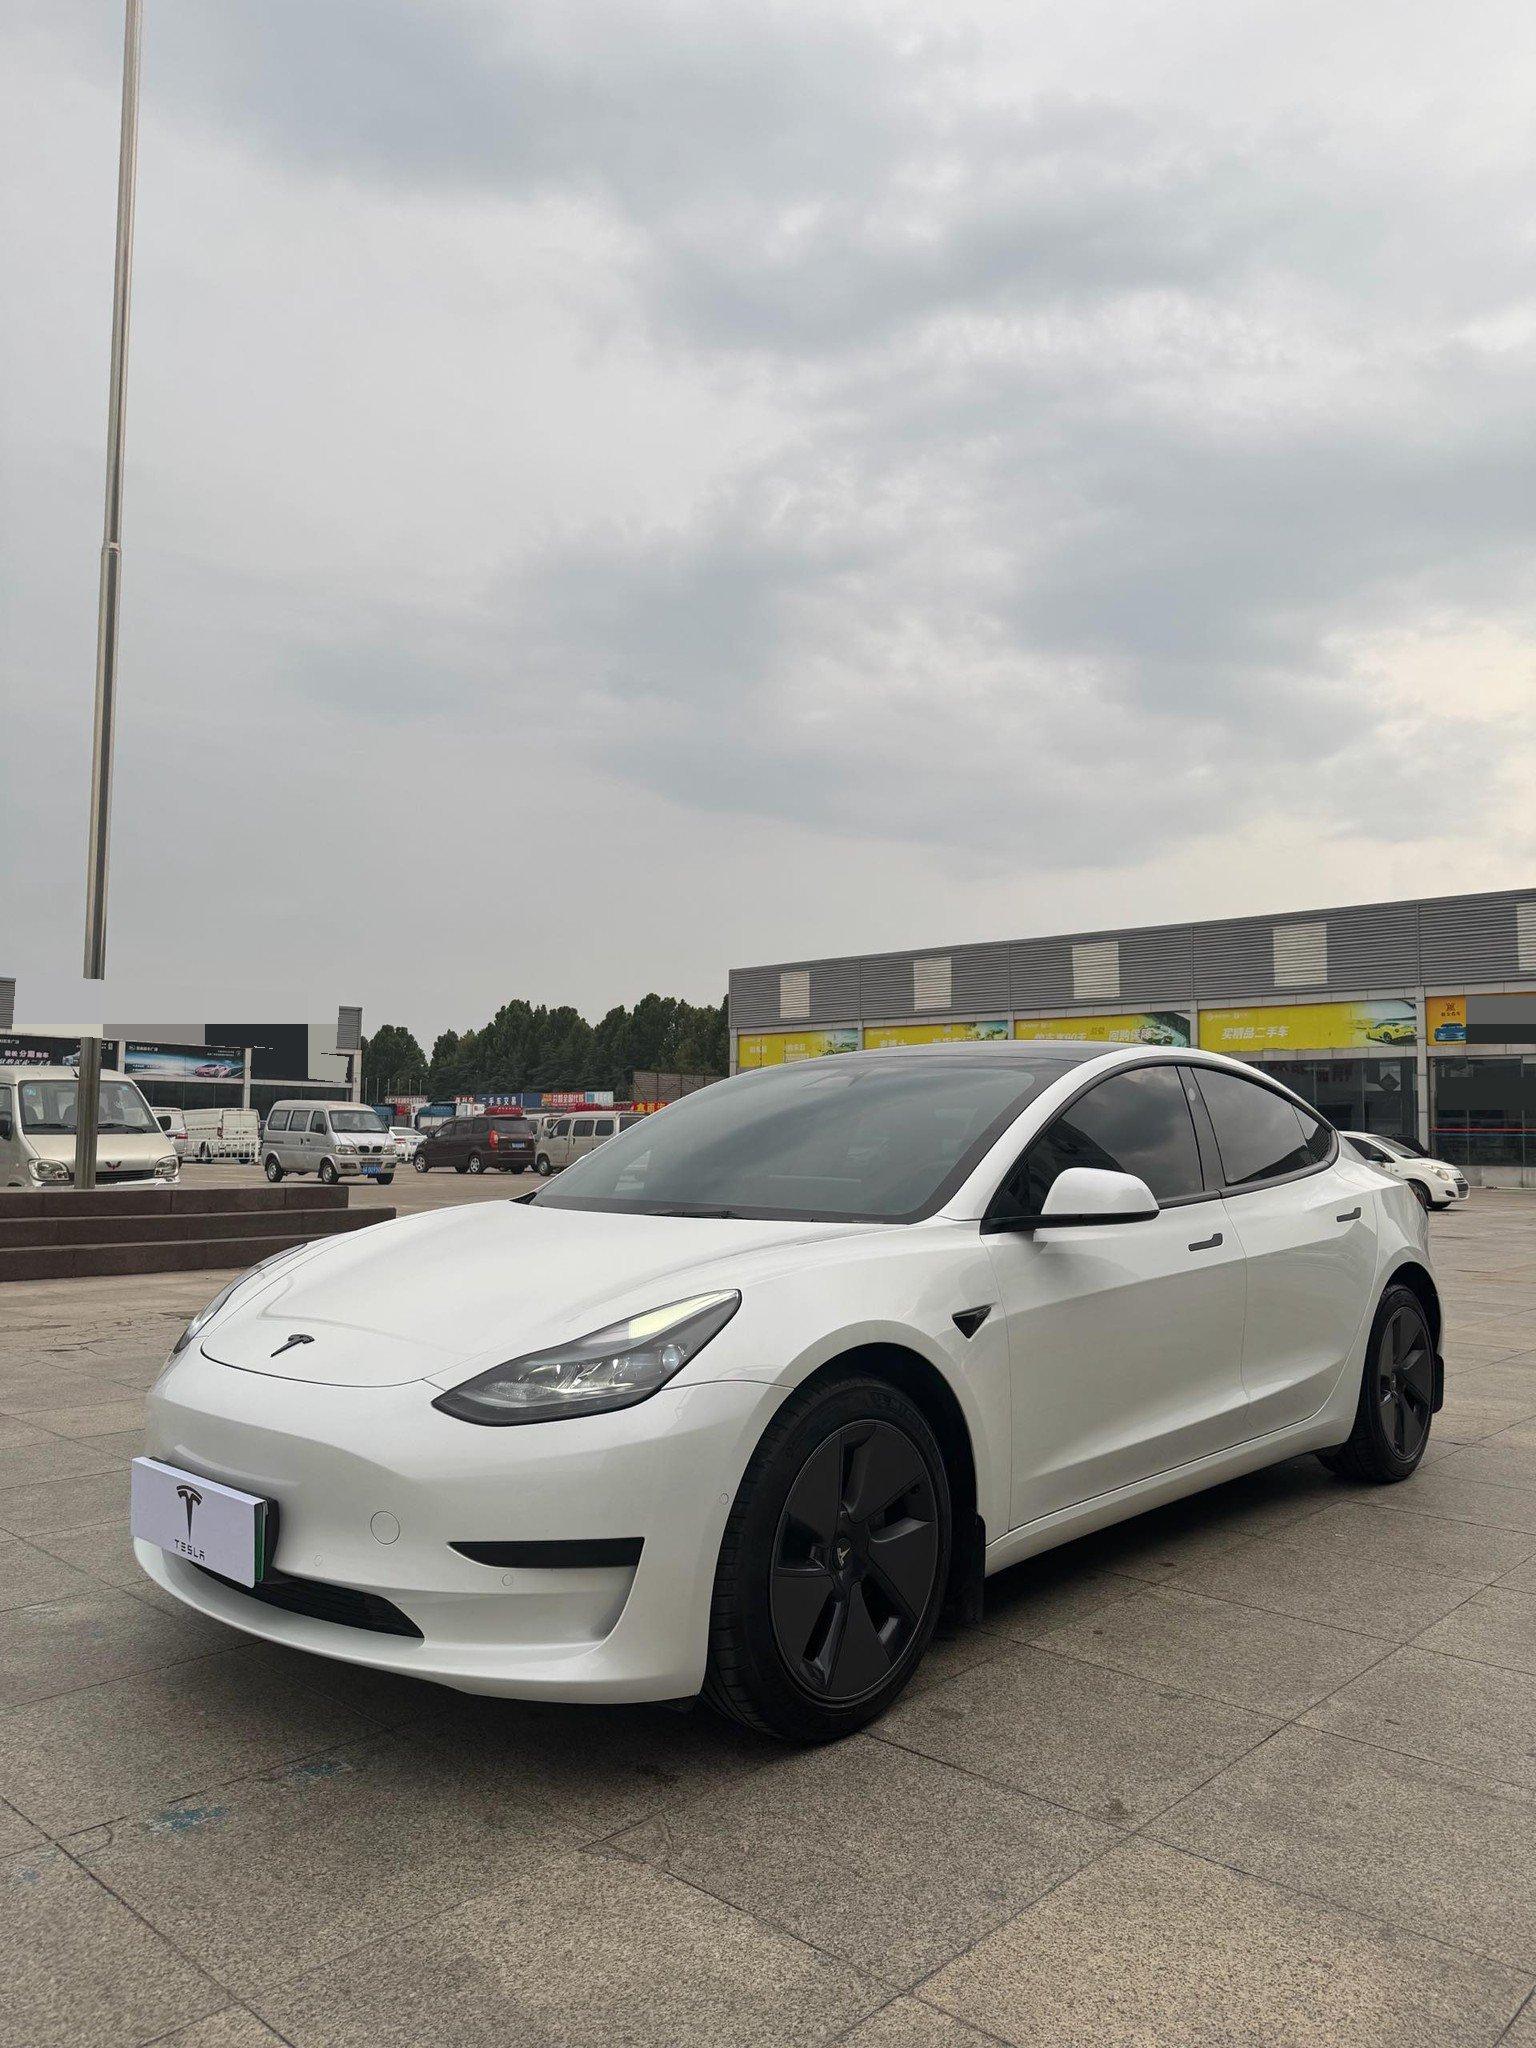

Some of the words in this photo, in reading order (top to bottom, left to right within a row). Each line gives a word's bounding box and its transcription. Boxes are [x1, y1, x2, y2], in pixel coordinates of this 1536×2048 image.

[1221, 1025, 1290, 1040] 买精品二手车
[481, 1095, 518, 1106] 二手车交易
[174, 1539, 205, 1561] TESLA
